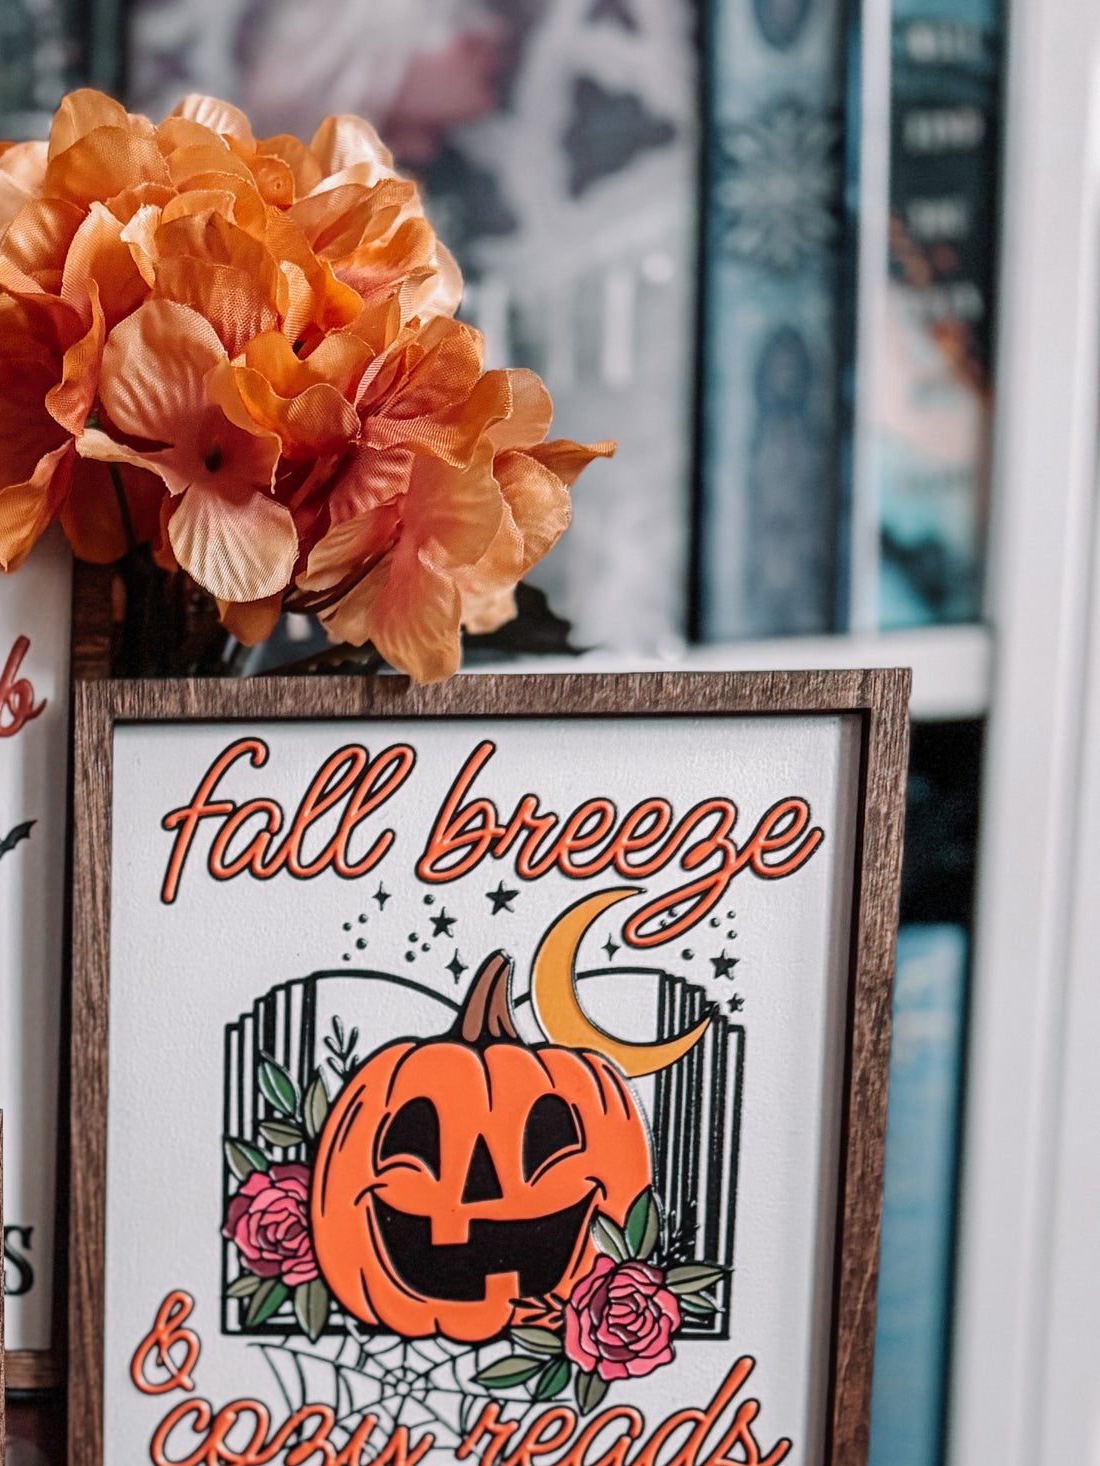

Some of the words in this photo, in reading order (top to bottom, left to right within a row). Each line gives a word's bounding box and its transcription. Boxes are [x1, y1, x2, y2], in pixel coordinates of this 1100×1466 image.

[161, 737, 417, 904] fall
[414, 740, 824, 948] breeze
[130, 1290, 200, 1395] &
